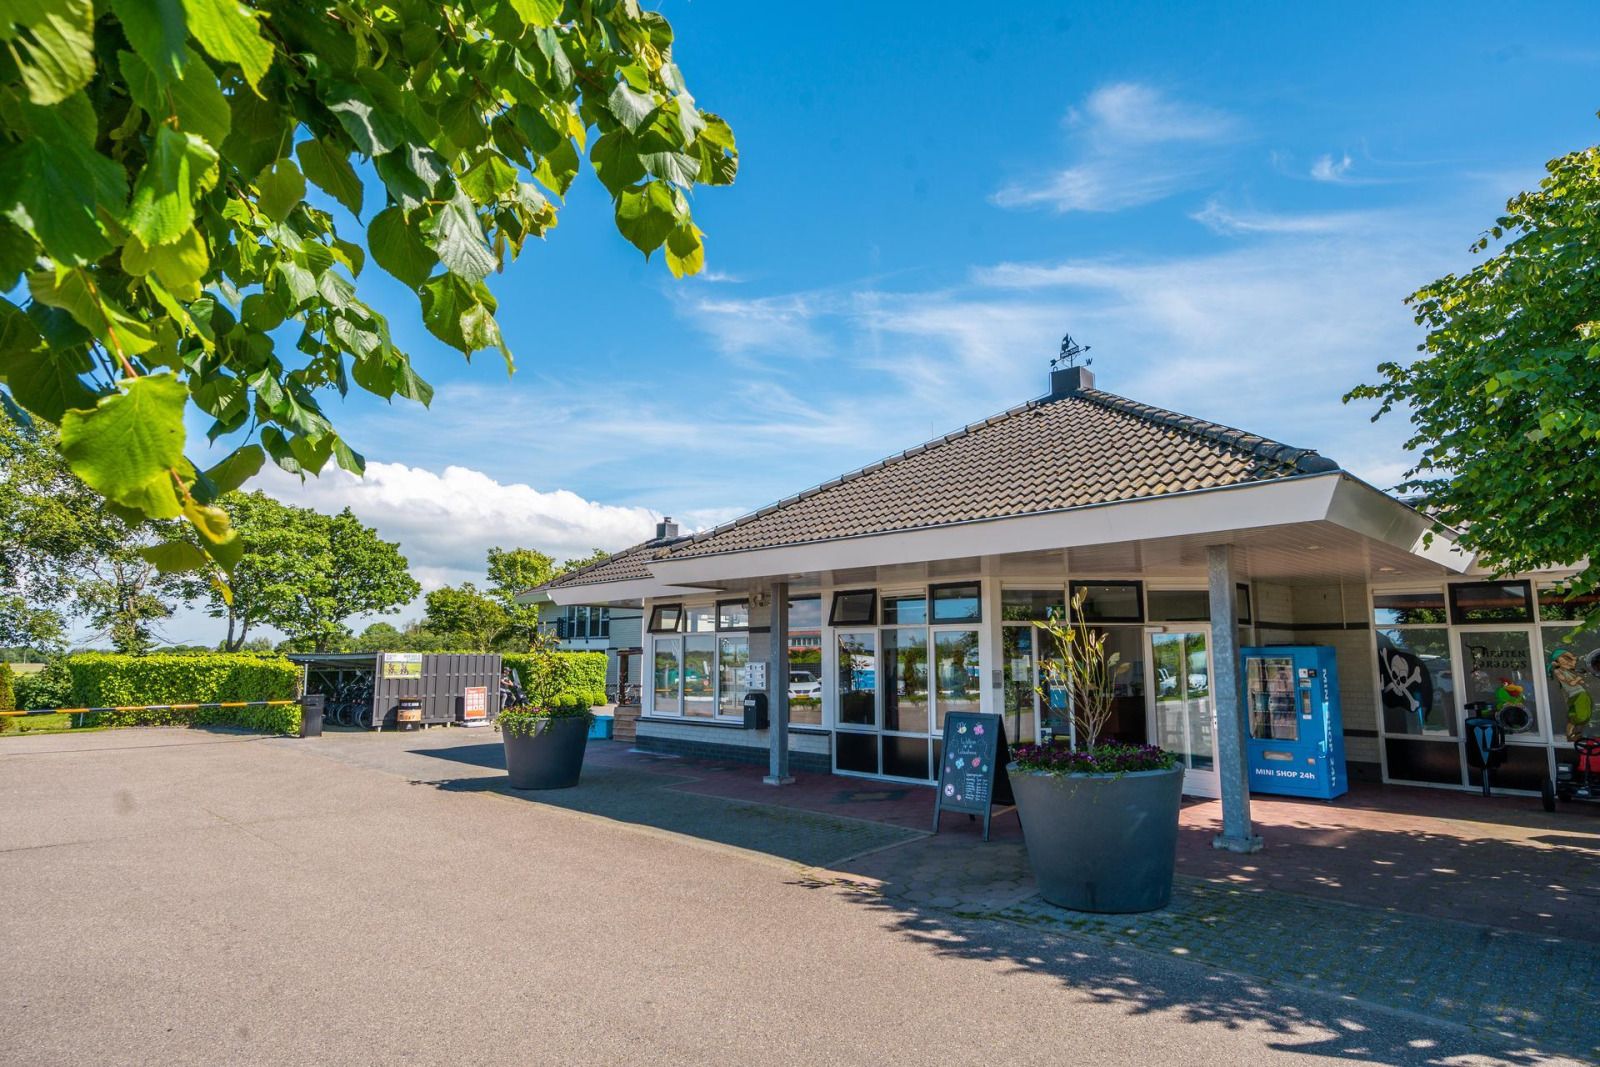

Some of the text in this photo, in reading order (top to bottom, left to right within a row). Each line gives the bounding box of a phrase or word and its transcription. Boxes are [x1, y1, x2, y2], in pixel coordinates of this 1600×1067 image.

[1321, 668, 1329, 704] MINI
[1255, 768, 1316, 780] MINI SHOP 24h
